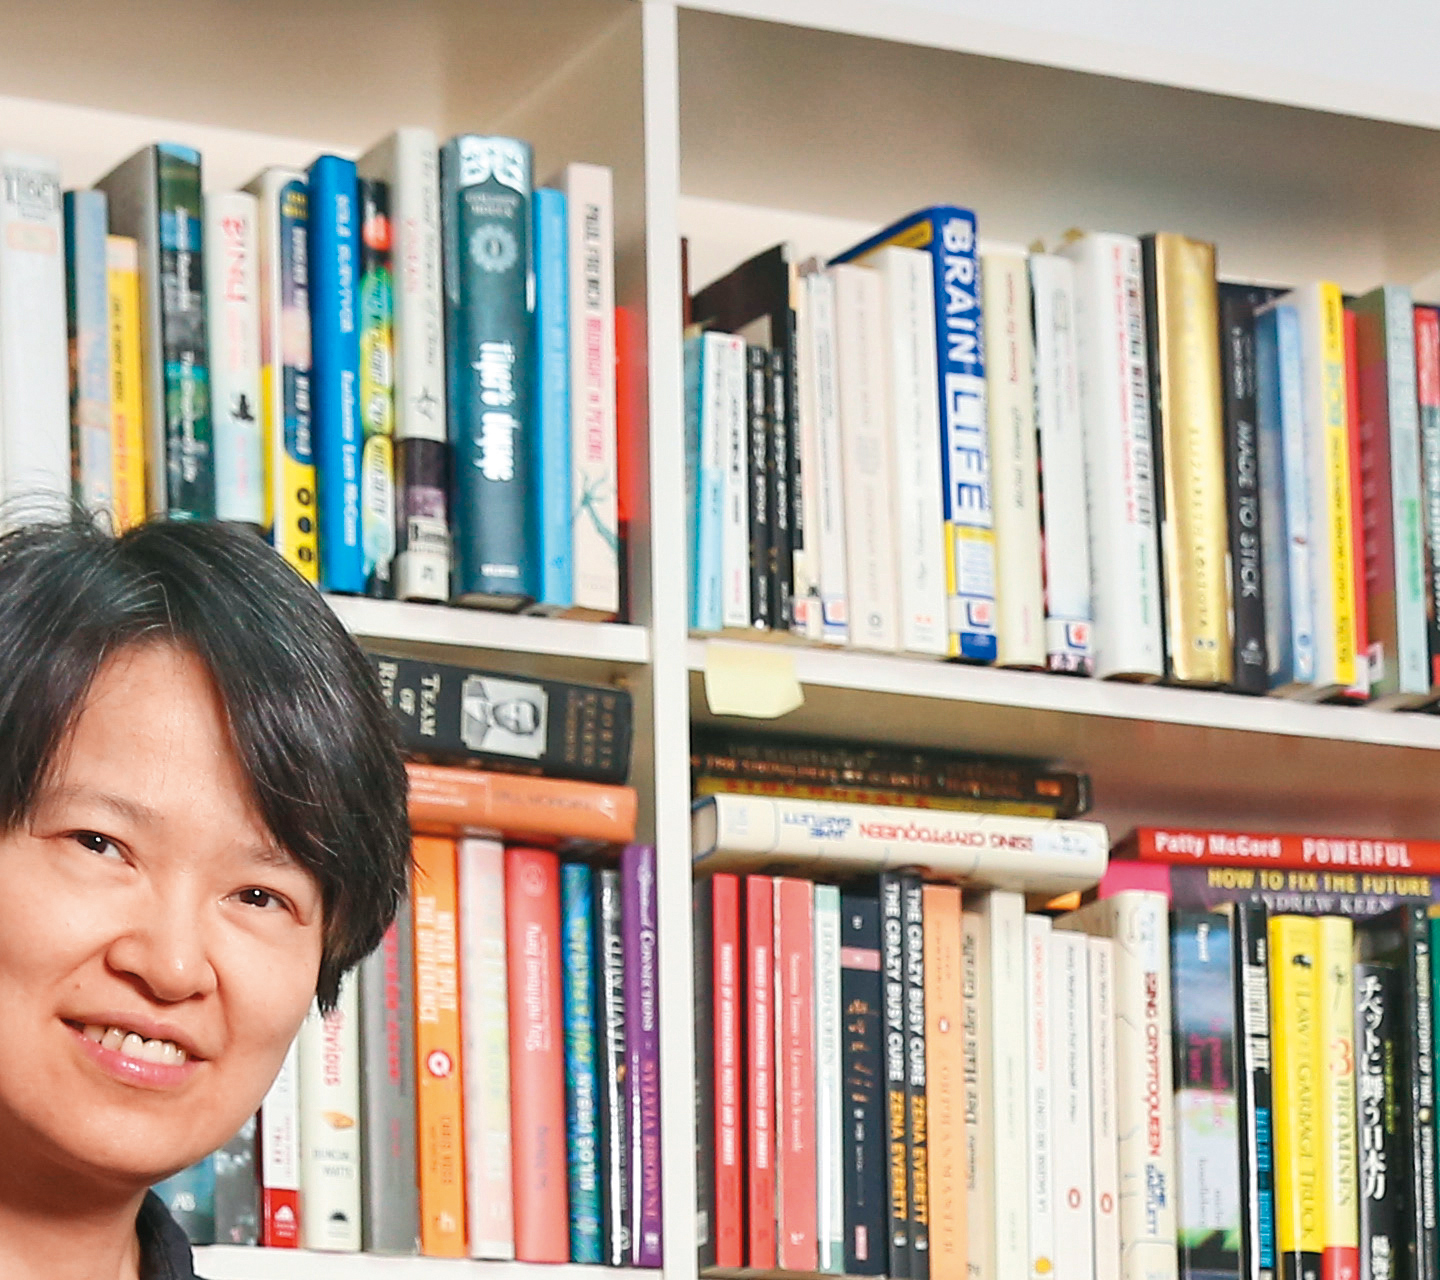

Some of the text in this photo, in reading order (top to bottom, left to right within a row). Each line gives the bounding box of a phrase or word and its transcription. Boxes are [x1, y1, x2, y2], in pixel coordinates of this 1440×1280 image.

[951, 388, 986, 512] LIFE
[1237, 421, 1256, 488] MADE
[1239, 496, 1258, 527] TO
[1241, 532, 1260, 598] STICK
[399, 687, 416, 716] OF
[419, 673, 441, 737] TEAM
[1155, 832, 1411, 868] Patty McCord POWERFUL
[1207, 868, 1432, 898] HOW TO FIX THE FUTURE
[1340, 896, 1394, 916] KEEN
[885, 883, 905, 1082] THE CRAZY BUSY CURE
[907, 888, 926, 1087] THE CRAZY BUSY CURE
[889, 1090, 908, 1221] ZENA EVERETT
[911, 1094, 930, 1225] ZENA EVERETT
